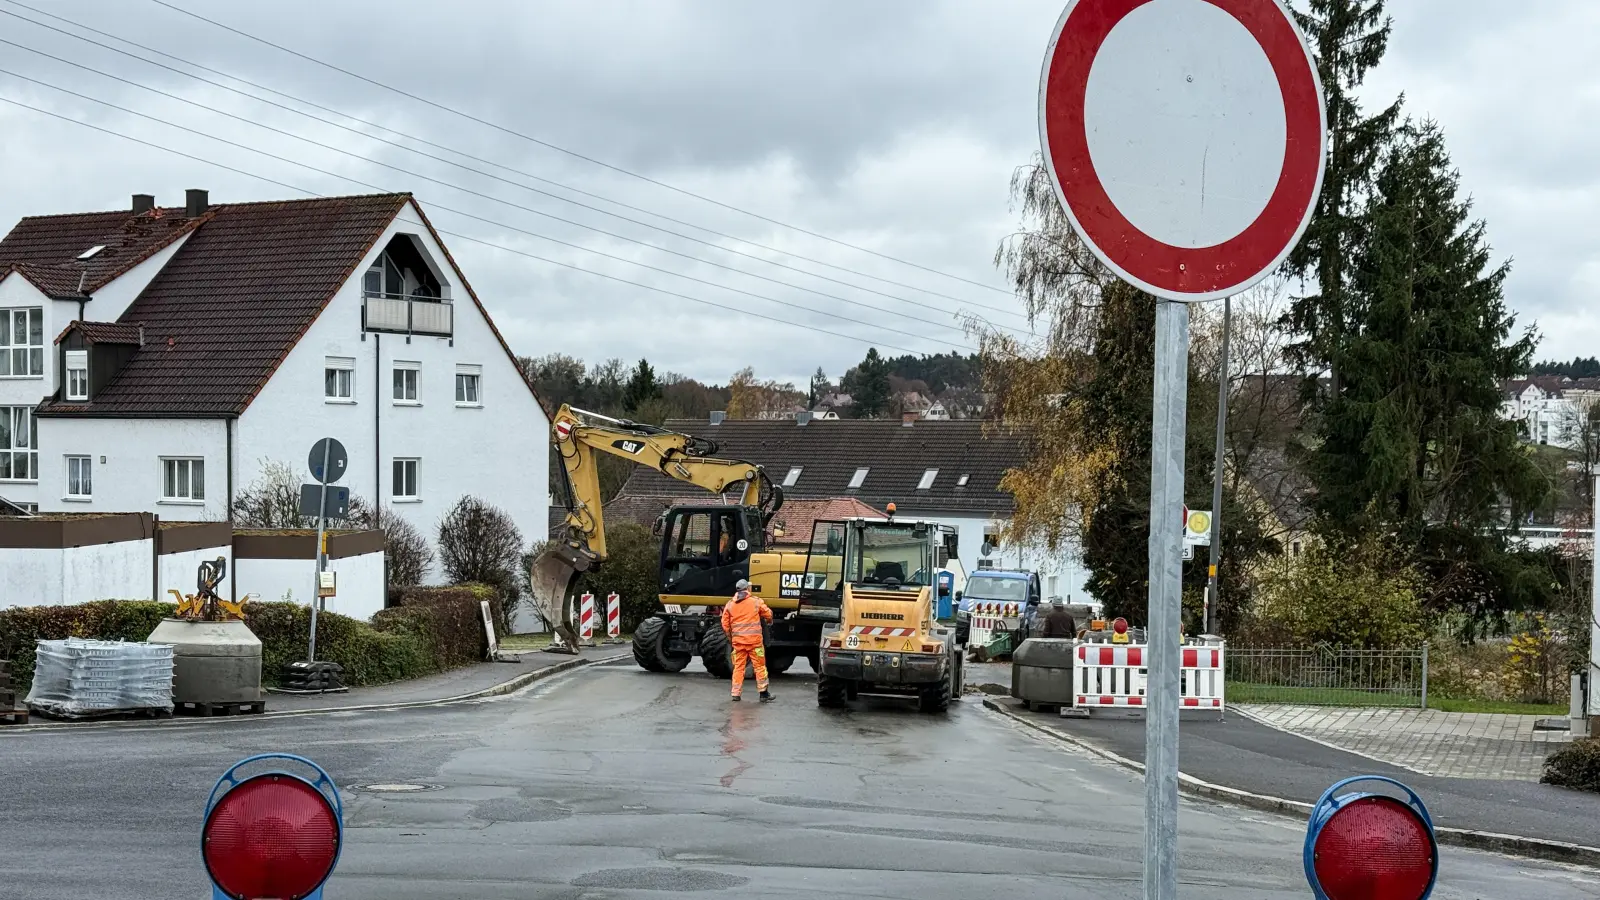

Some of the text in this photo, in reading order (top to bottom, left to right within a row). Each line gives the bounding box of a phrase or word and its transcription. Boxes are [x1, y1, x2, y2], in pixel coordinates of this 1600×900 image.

[622, 441, 637, 452] CAT
[739, 541, 746, 550] 20
[782, 574, 803, 588] CAT
[861, 612, 904, 620] LIEBHERR
[848, 636, 858, 647] 20
